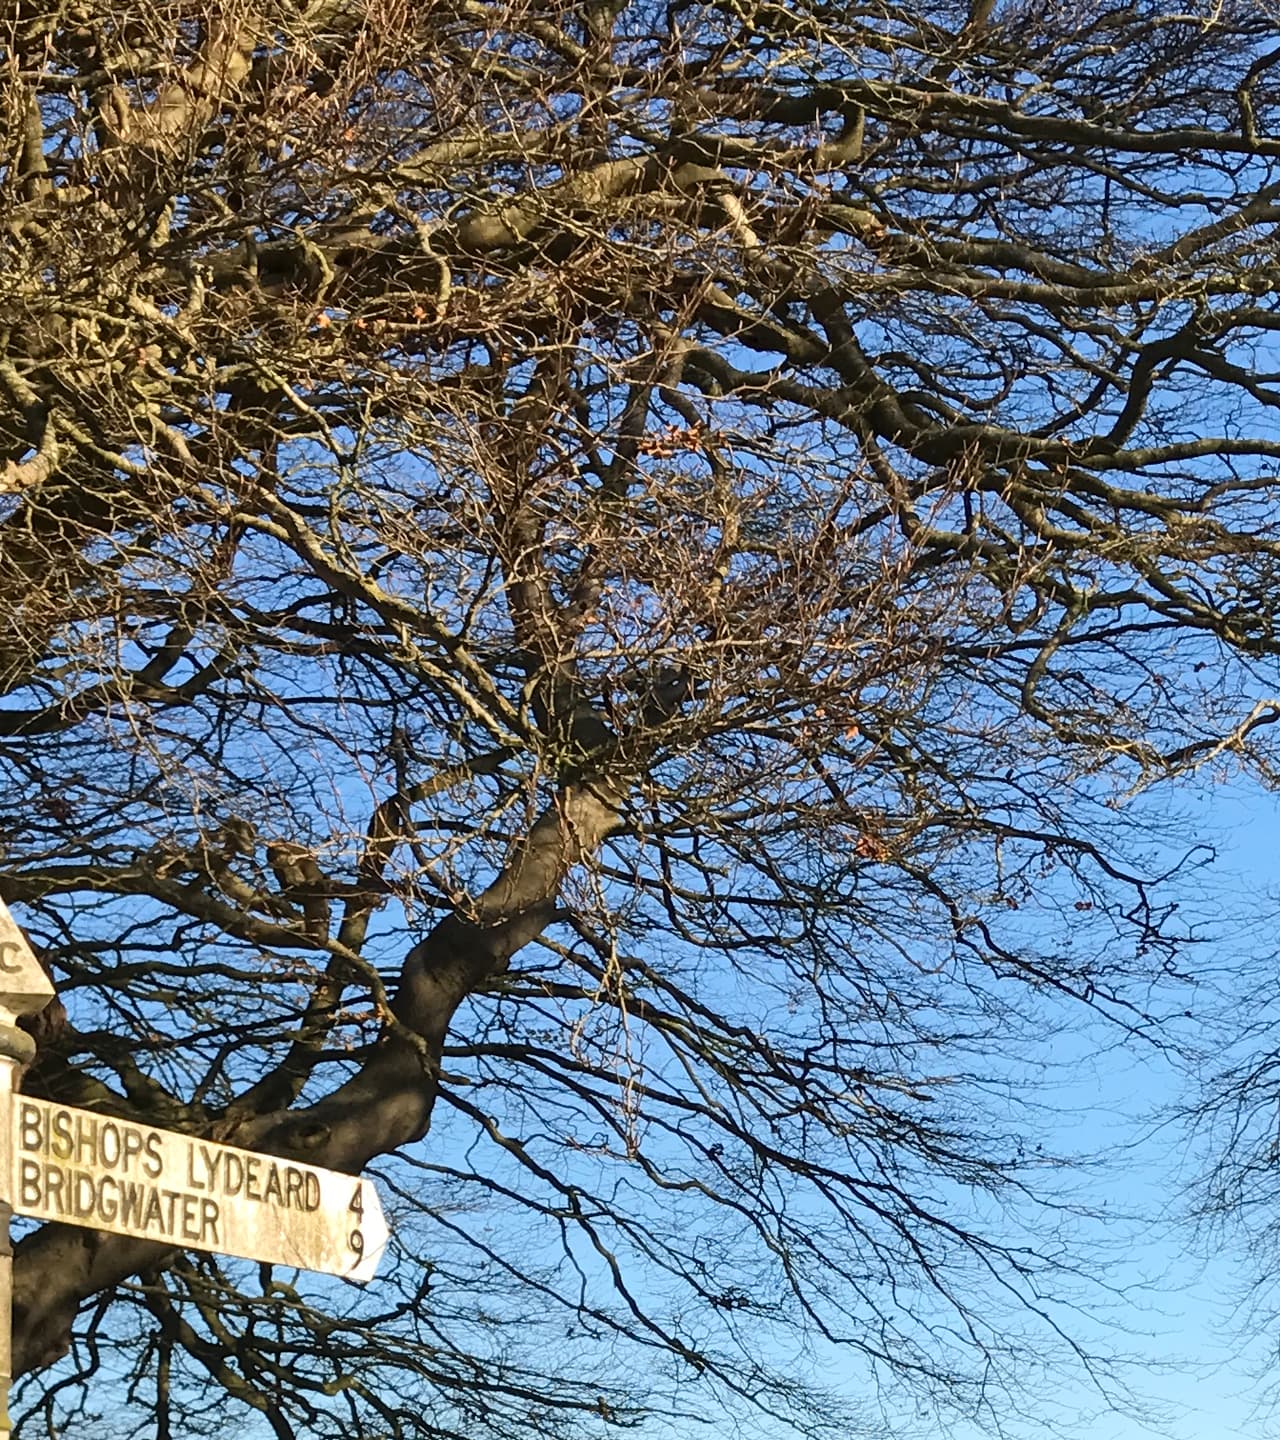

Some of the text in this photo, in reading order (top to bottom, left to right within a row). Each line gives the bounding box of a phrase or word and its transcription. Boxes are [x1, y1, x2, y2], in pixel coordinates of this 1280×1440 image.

[19, 1102, 365, 1224] BISHOPS LYDEARD 4
[19, 1158, 365, 1270] BRIDGWATER 9
